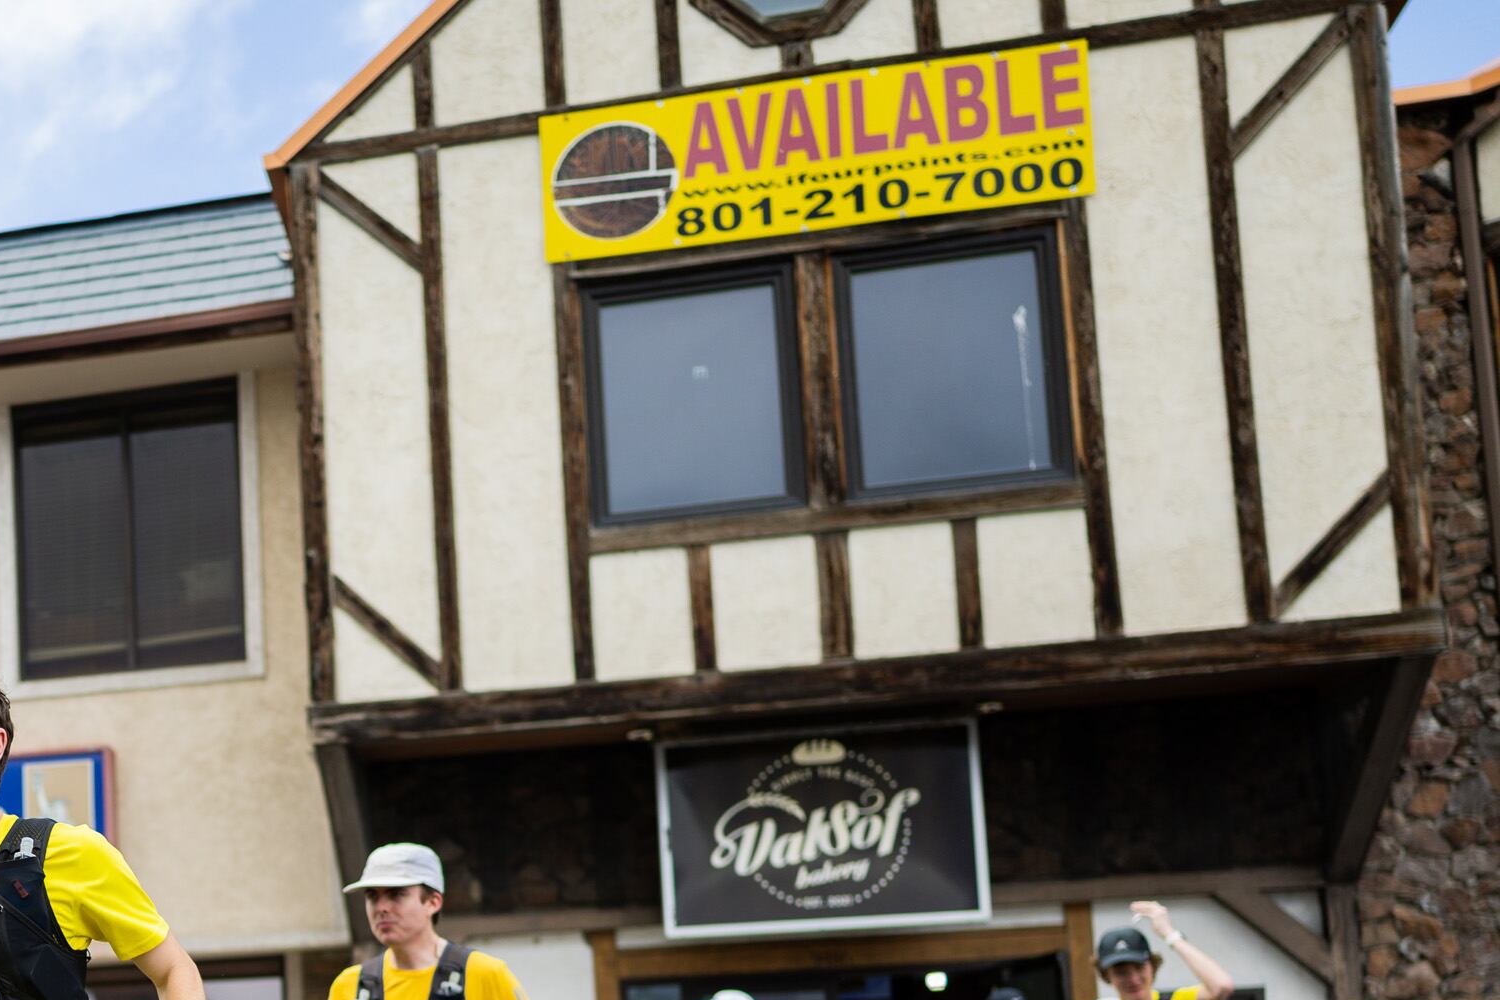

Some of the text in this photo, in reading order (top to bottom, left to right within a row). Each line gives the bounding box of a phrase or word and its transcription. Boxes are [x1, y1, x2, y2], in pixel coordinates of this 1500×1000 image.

[684, 48, 1085, 179] AVAILABLE
[676, 157, 1085, 237] 801-210-7000
[682, 139, 1085, 198] www.ifourpoints.com
